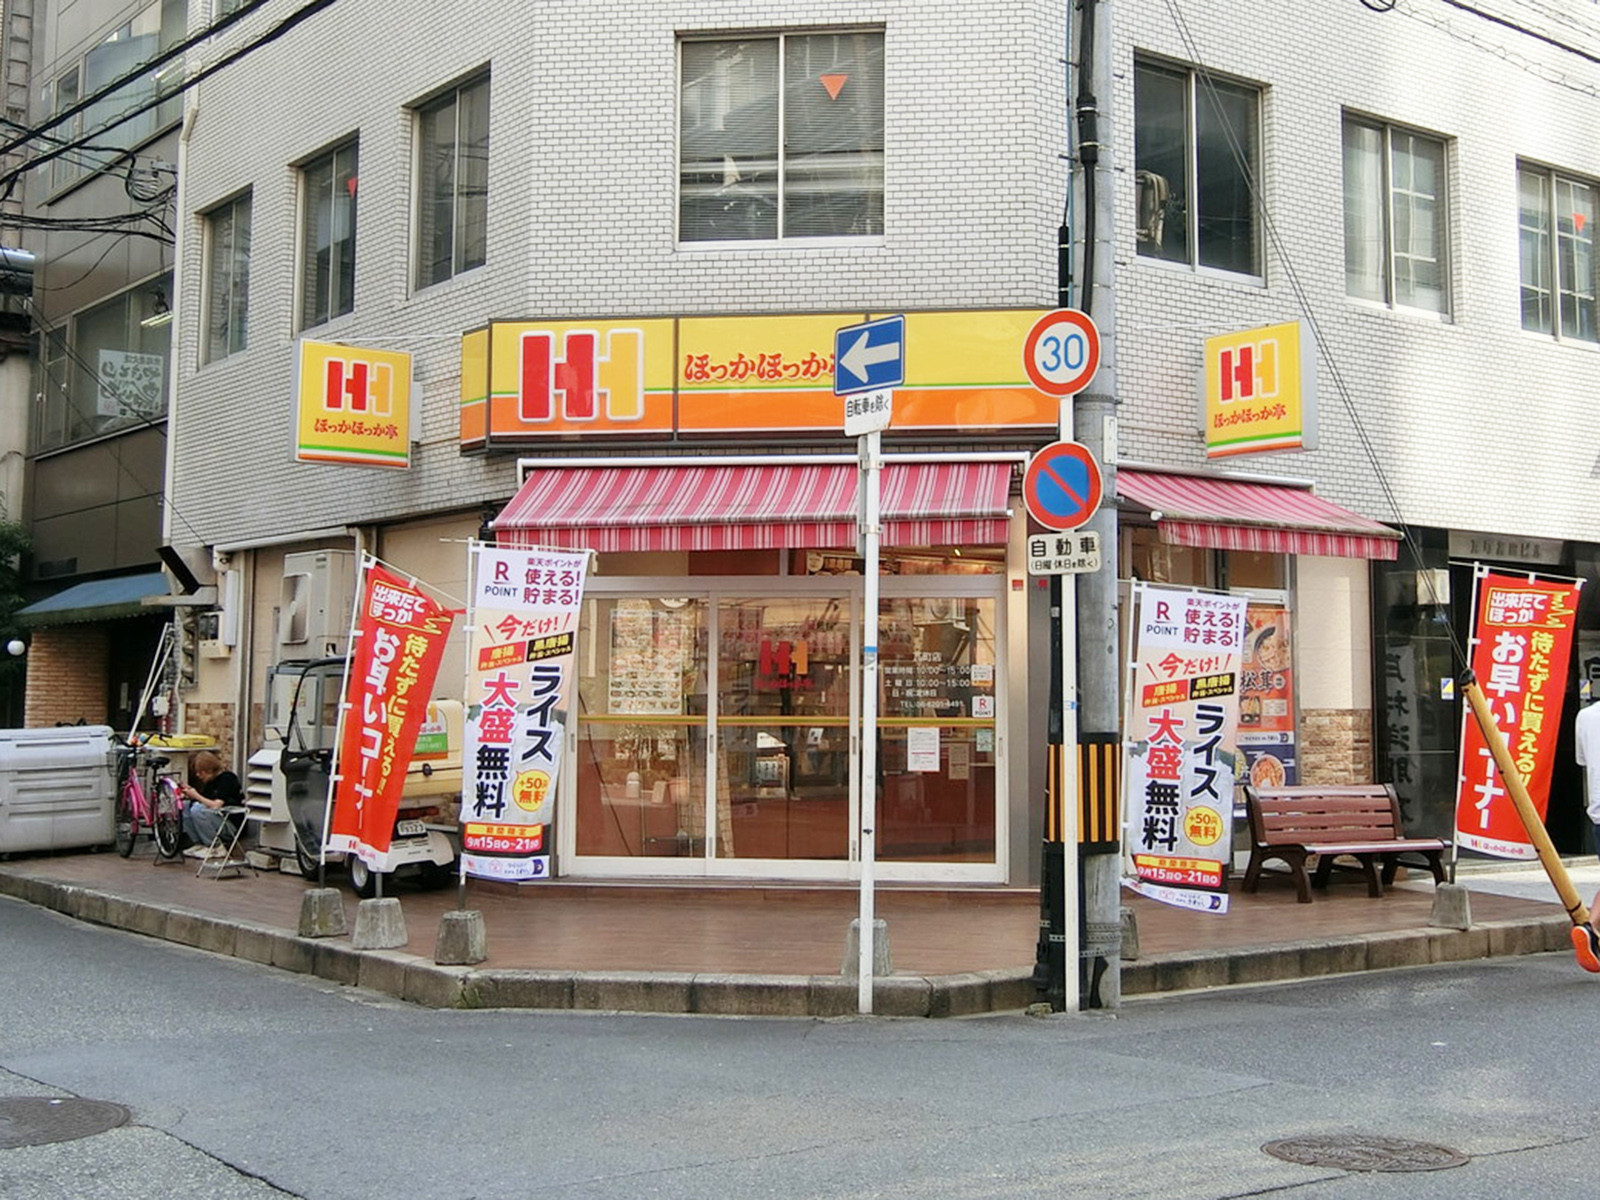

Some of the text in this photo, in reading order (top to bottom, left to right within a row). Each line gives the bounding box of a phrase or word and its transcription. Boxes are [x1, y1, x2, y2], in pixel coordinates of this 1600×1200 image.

[1042, 333, 1084, 372] 30
[683, 352, 836, 381] ほっかほっか
[847, 394, 890, 417] 自転車を除く
[1213, 404, 1287, 428] ほっかほっか亭
[314, 418, 398, 439] ほっかほっか亭
[1031, 537, 1096, 557] 自動車
[494, 561, 510, 581] R
[525, 568, 581, 587] 使える!
[372, 584, 427, 613] 出来たて
[484, 585, 518, 597] POINT
[522, 587, 579, 605] 貯まる!
[1490, 591, 1548, 610] 出来たて
[1156, 601, 1171, 621] R
[1184, 608, 1239, 629] 使える!
[1489, 608, 1534, 623] ほっか
[496, 614, 558, 640] 今だけ!
[1146, 625, 1178, 636] POINT
[1183, 627, 1239, 647] 貯まる!
[1158, 652, 1219, 678] 今だけ!
[521, 665, 560, 762] ライス
[979, 698, 987, 709] R
[473, 672, 519, 819] 大盛無料
[1190, 704, 1224, 800] ライス
[1141, 708, 1184, 853] 大盛無料
[1189, 825, 1218, 839] 無料
